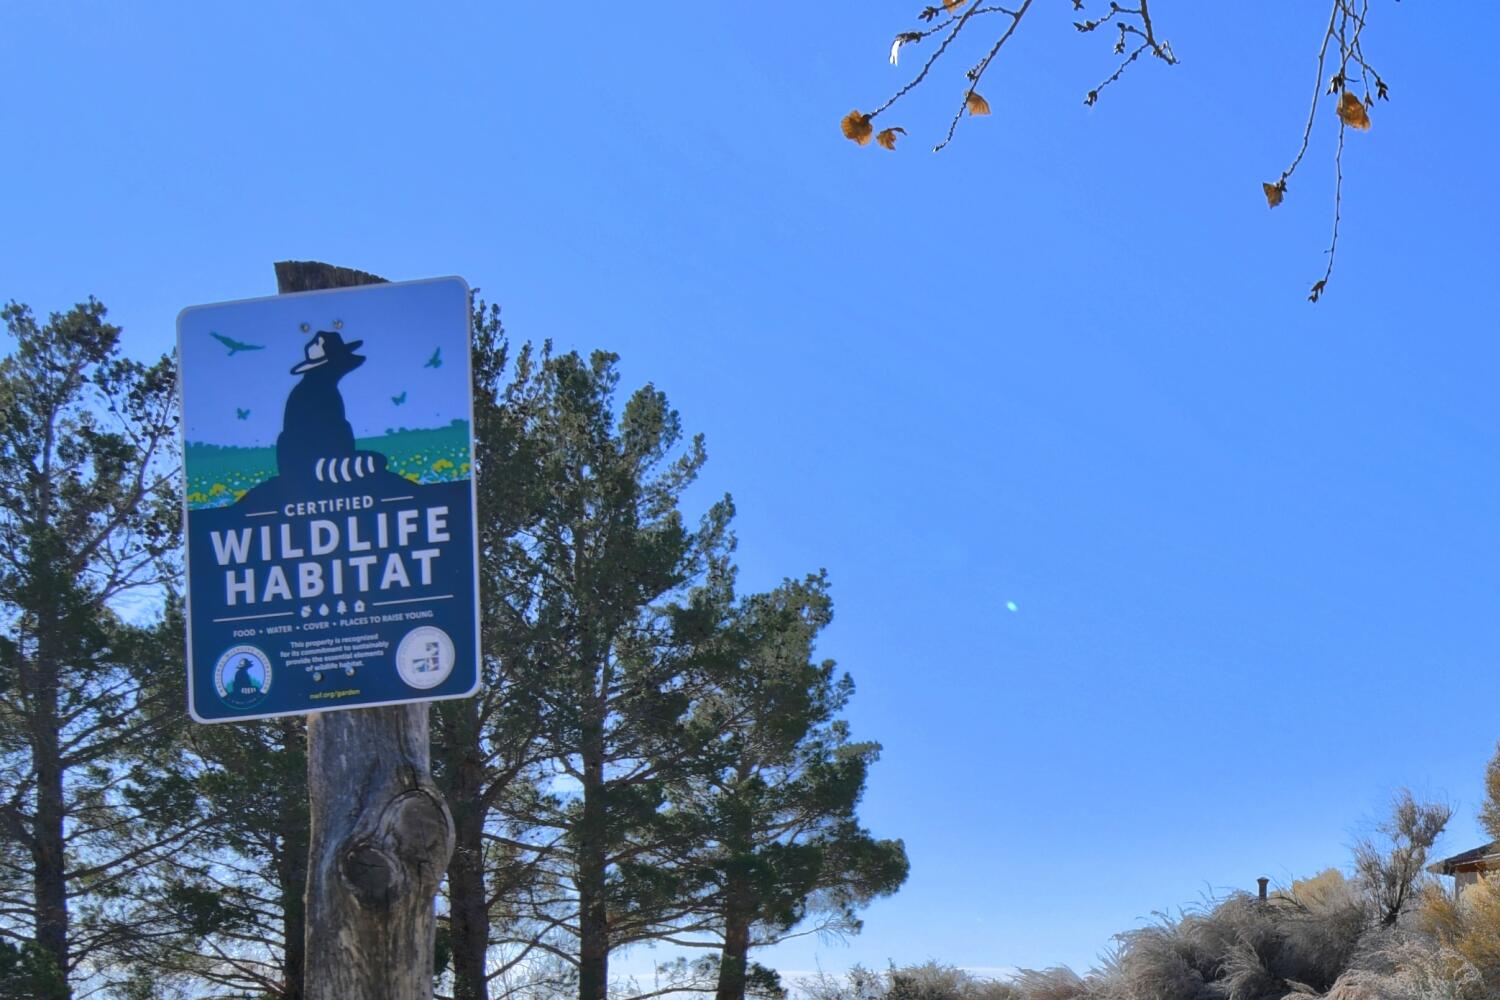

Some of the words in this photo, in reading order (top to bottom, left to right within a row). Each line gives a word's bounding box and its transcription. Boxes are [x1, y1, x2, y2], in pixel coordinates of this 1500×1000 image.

[284, 495, 373, 517] CERTIFIED
[210, 506, 450, 566] WILDLIFE
[226, 548, 440, 606] HABITAT
[233, 628, 256, 637] FOOD
[266, 625, 293, 634] WATER
[303, 621, 330, 631] COVER
[340, 616, 369, 626] PLACES
[370, 615, 381, 623] TO
[382, 613, 404, 622] RAISE
[405, 610, 434, 619] YOUNG
[290, 641, 304, 649] This
[305, 638, 334, 648] property
[342, 634, 378, 643] recognized
[301, 646, 343, 656] commitment
[352, 641, 389, 650] sustainably
[286, 657, 311, 667] provide
[324, 653, 352, 661] essential
[354, 650, 384, 659] elements
[314, 662, 338, 671] wildlife
